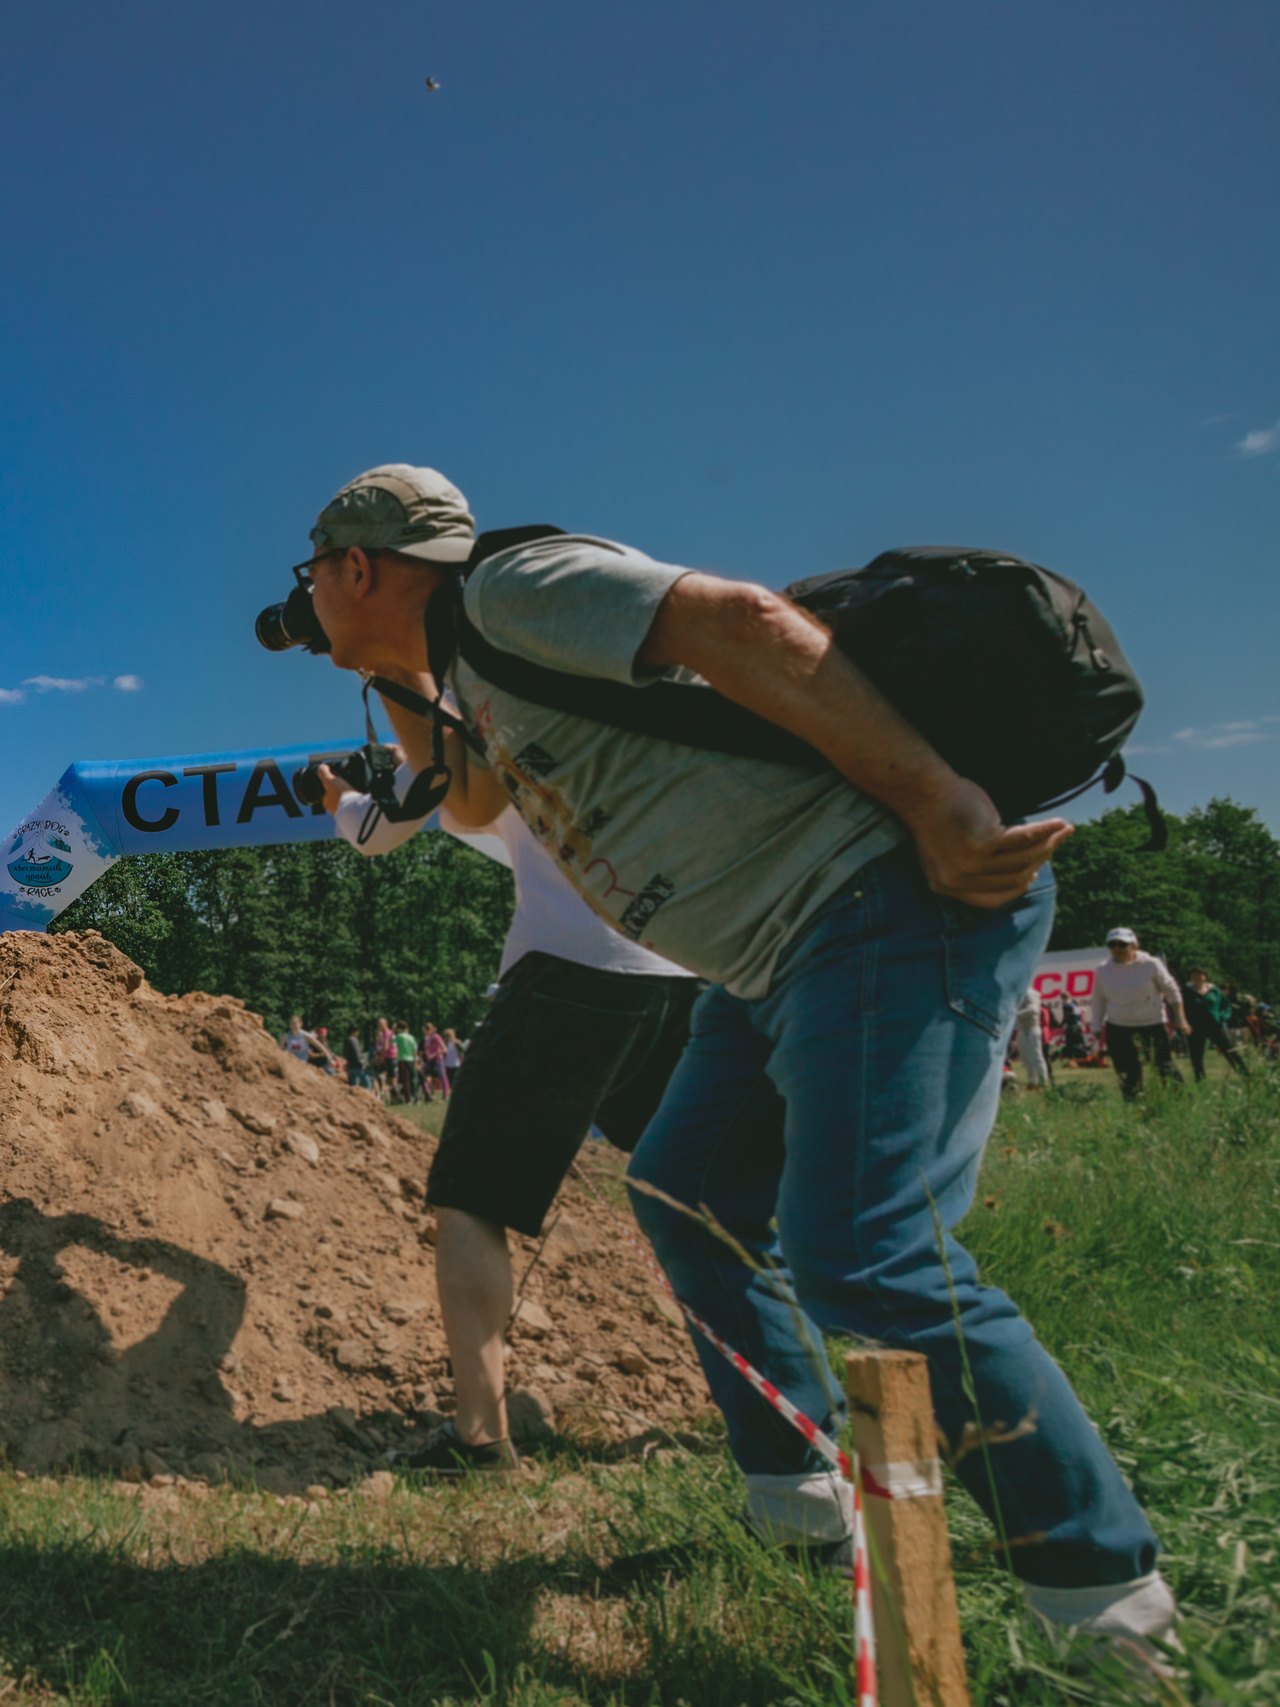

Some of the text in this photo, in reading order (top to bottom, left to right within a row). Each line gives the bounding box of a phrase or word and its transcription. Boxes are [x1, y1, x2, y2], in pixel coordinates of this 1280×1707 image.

[17, 820, 66, 836] CRAZY DOG
[26, 887, 55, 898] RACE
